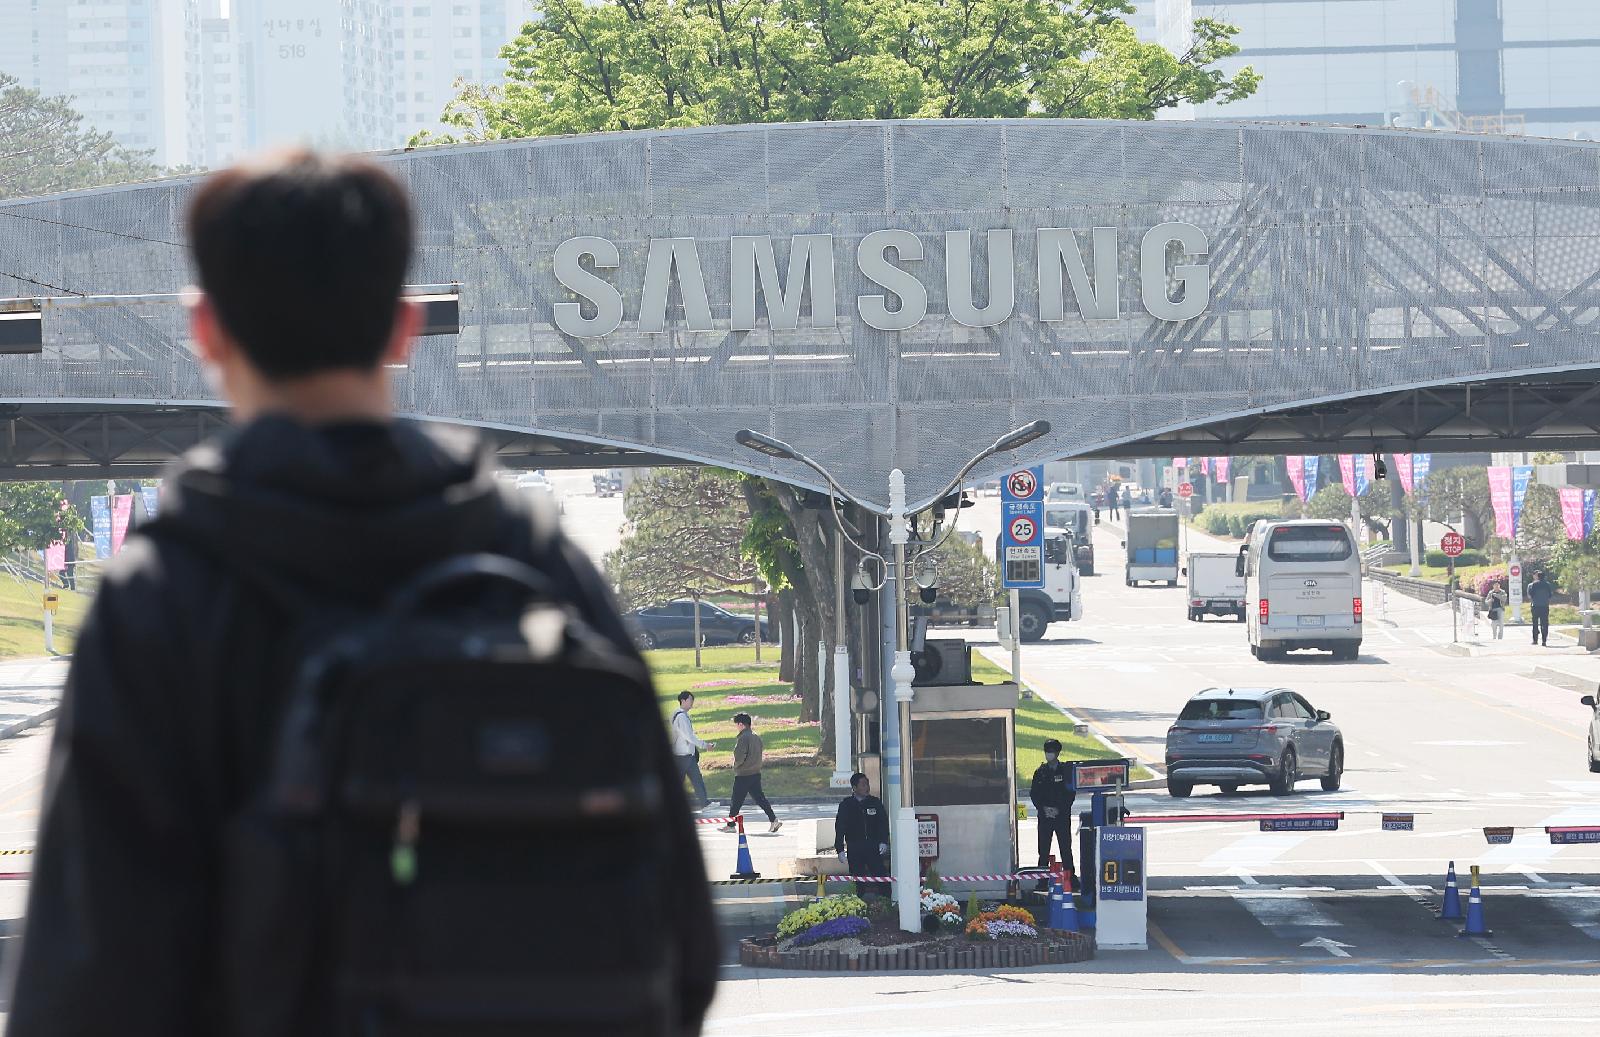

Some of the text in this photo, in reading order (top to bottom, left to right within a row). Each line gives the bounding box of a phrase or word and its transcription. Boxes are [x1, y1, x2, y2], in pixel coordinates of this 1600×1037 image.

[279, 44, 306, 59] 518
[553, 222, 1210, 339] SAMSUNG
[1015, 524, 1031, 536] 25
[1445, 536, 1461, 545] 정지
